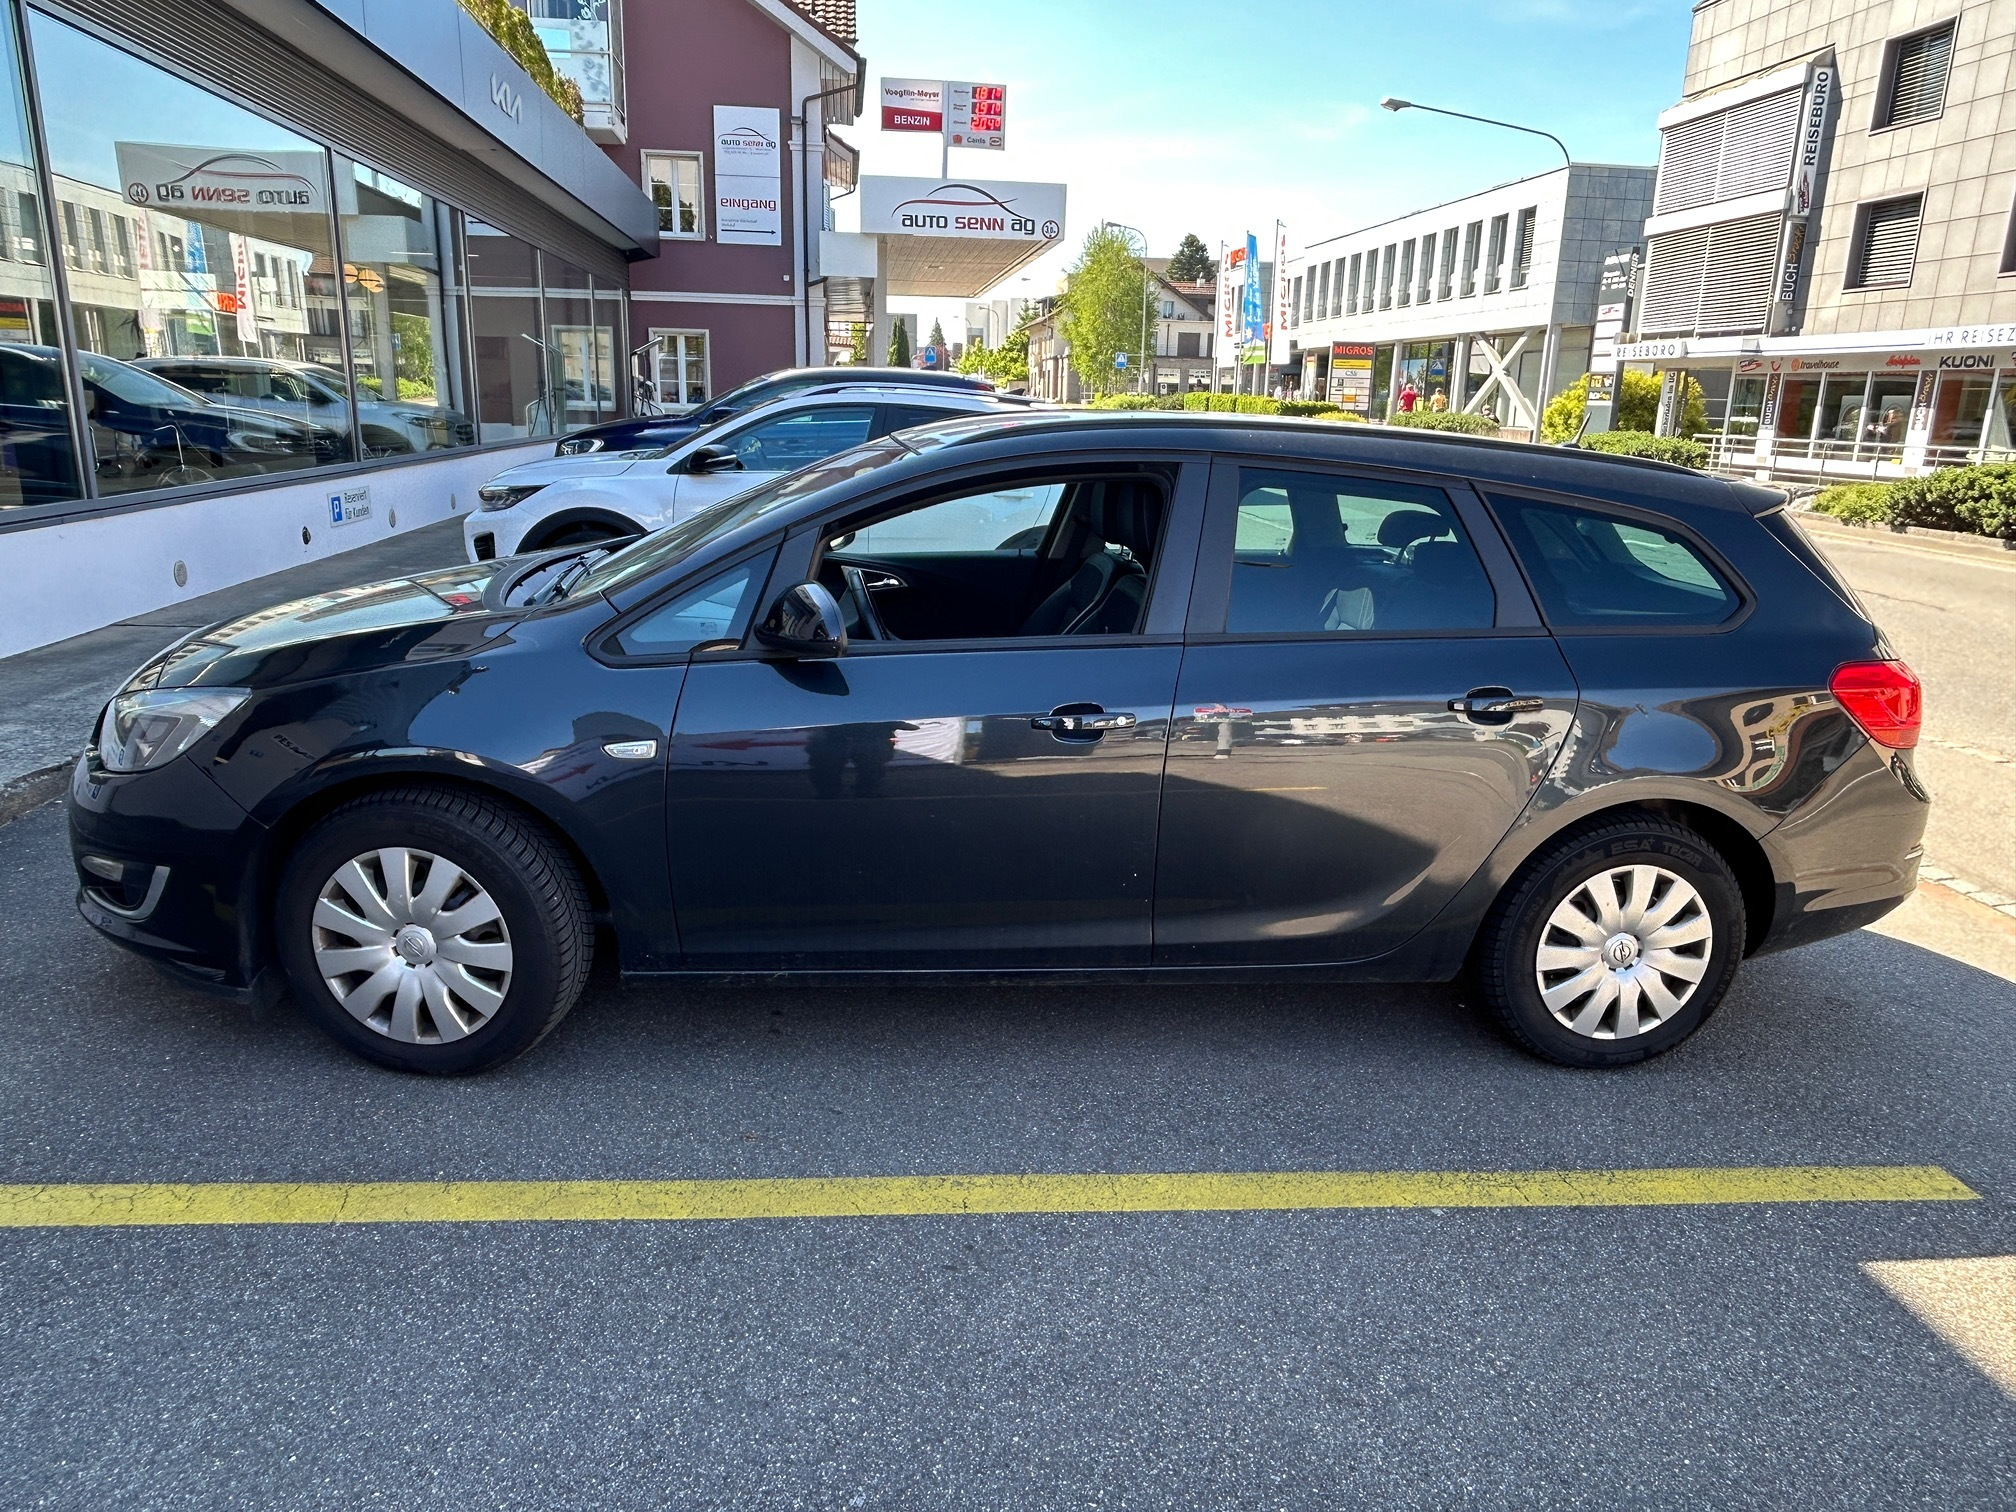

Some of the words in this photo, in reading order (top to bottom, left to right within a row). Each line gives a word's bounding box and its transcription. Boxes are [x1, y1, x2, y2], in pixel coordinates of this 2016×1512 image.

[490, 72, 522, 124] KIA
[894, 115, 930, 125] BENZIN
[1804, 71, 1829, 166] REISEBÜRO
[1627, 253, 1640, 297] DENNER
[1781, 263, 1798, 301] BUCH
[1928, 331, 1954, 344] IHR
[1334, 345, 1374, 356] MIGROS
[1939, 354, 1996, 369] KUONI
[1763, 400, 1774, 425] BUCH
